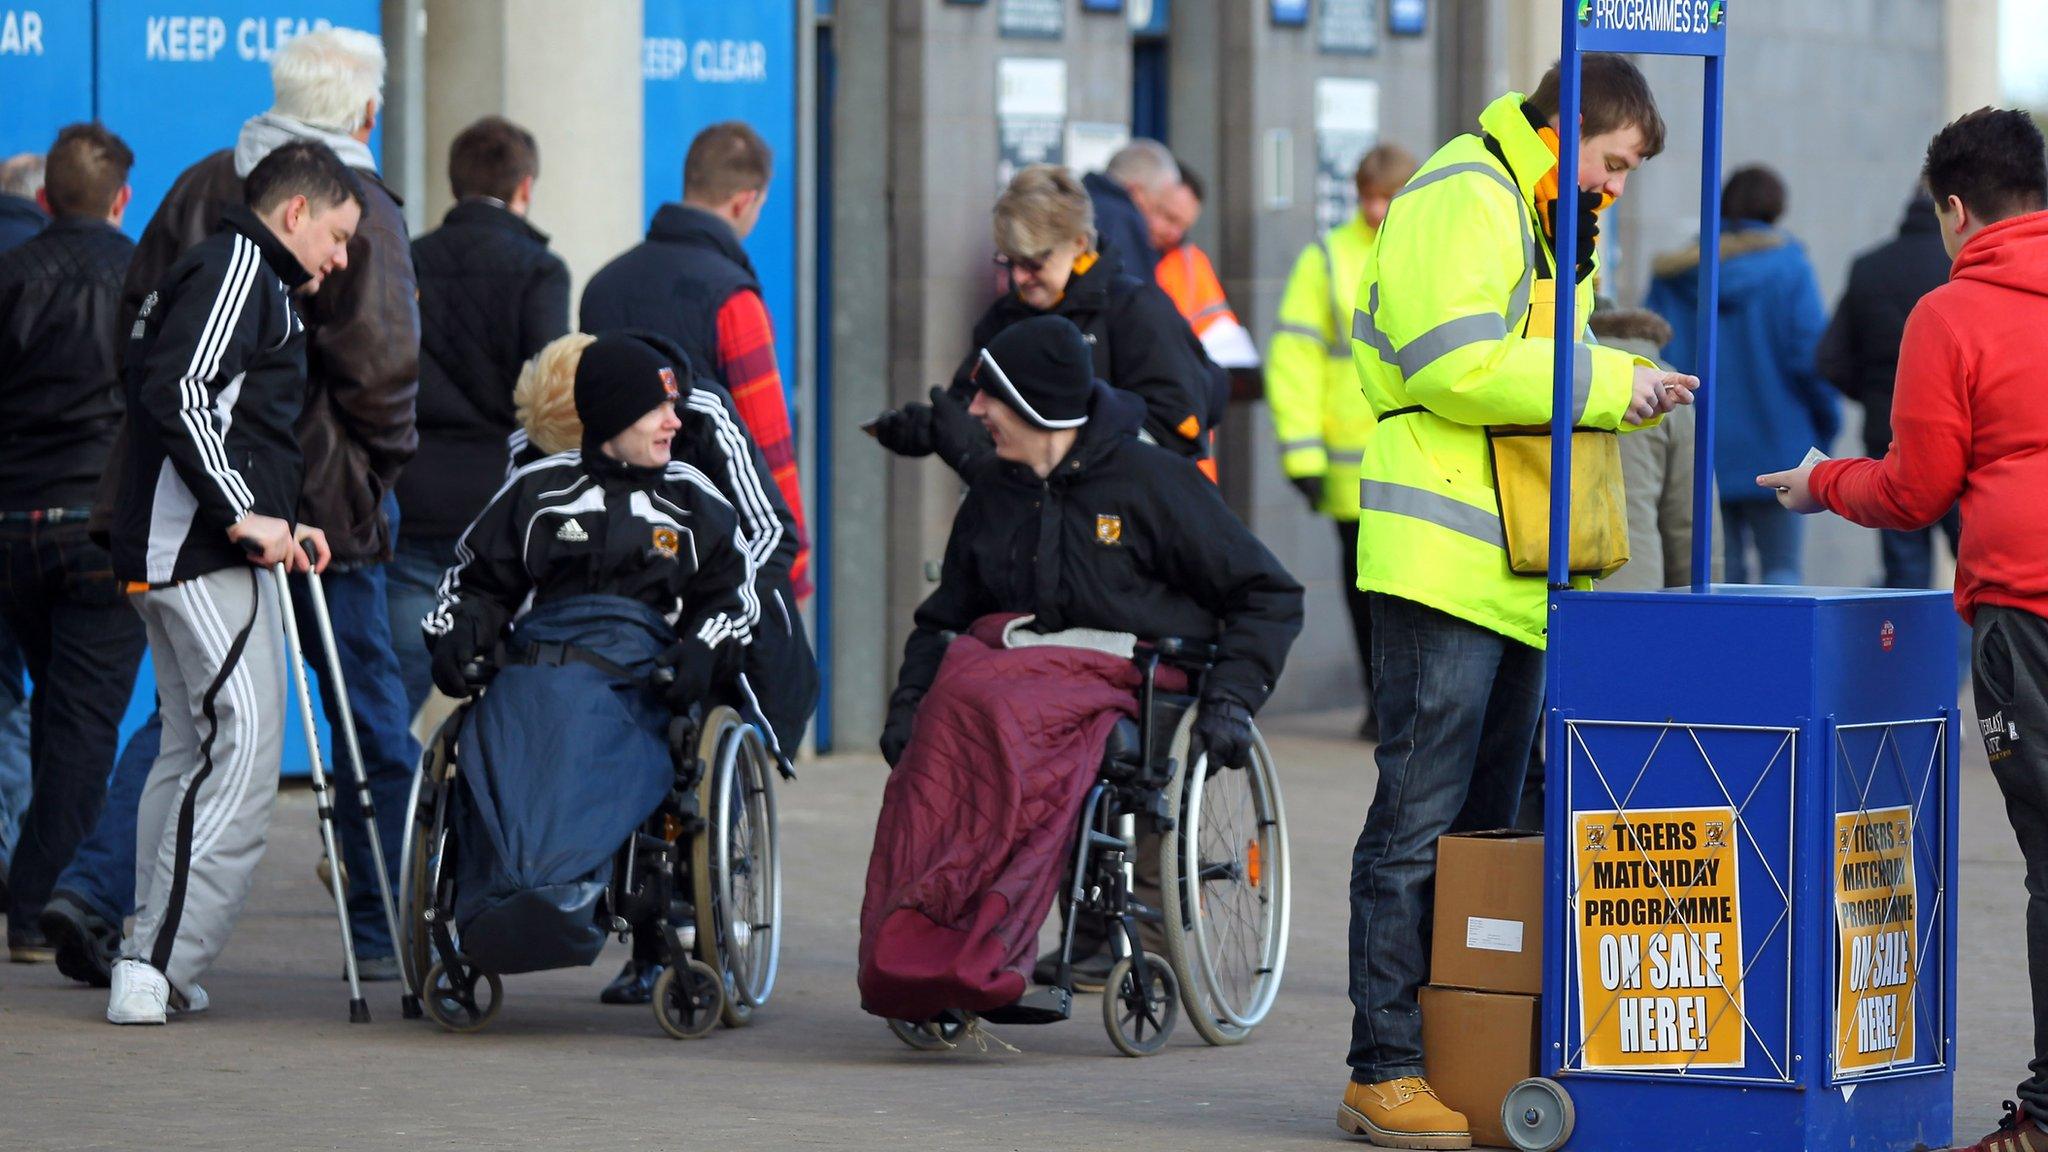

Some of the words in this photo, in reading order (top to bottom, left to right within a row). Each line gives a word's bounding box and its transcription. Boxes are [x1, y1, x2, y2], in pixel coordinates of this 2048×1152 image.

[1596, 0, 1691, 33] PROGRAMMES
[1693, 2, 1709, 34] £3
[146, 15, 226, 61] KEEP
[236, 17, 333, 62] CLE
[643, 37, 687, 80] EEP
[692, 39, 767, 83] CLEAR
[1613, 822, 1697, 852] TIGERS
[1854, 821, 1894, 853] TIGERS
[1594, 858, 1720, 889] MATCHDAY
[1843, 857, 1905, 891] MATCHDAY
[1585, 897, 1732, 926] PROGRAMME
[1841, 894, 1913, 928] PROGRAMME
[1600, 933, 1642, 991] ON
[1649, 932, 1723, 990] SALE
[1850, 935, 1872, 992] ON
[1872, 930, 1908, 989] SALE
[1619, 996, 1708, 1052] HERE!
[1859, 994, 1897, 1054] HERE!
